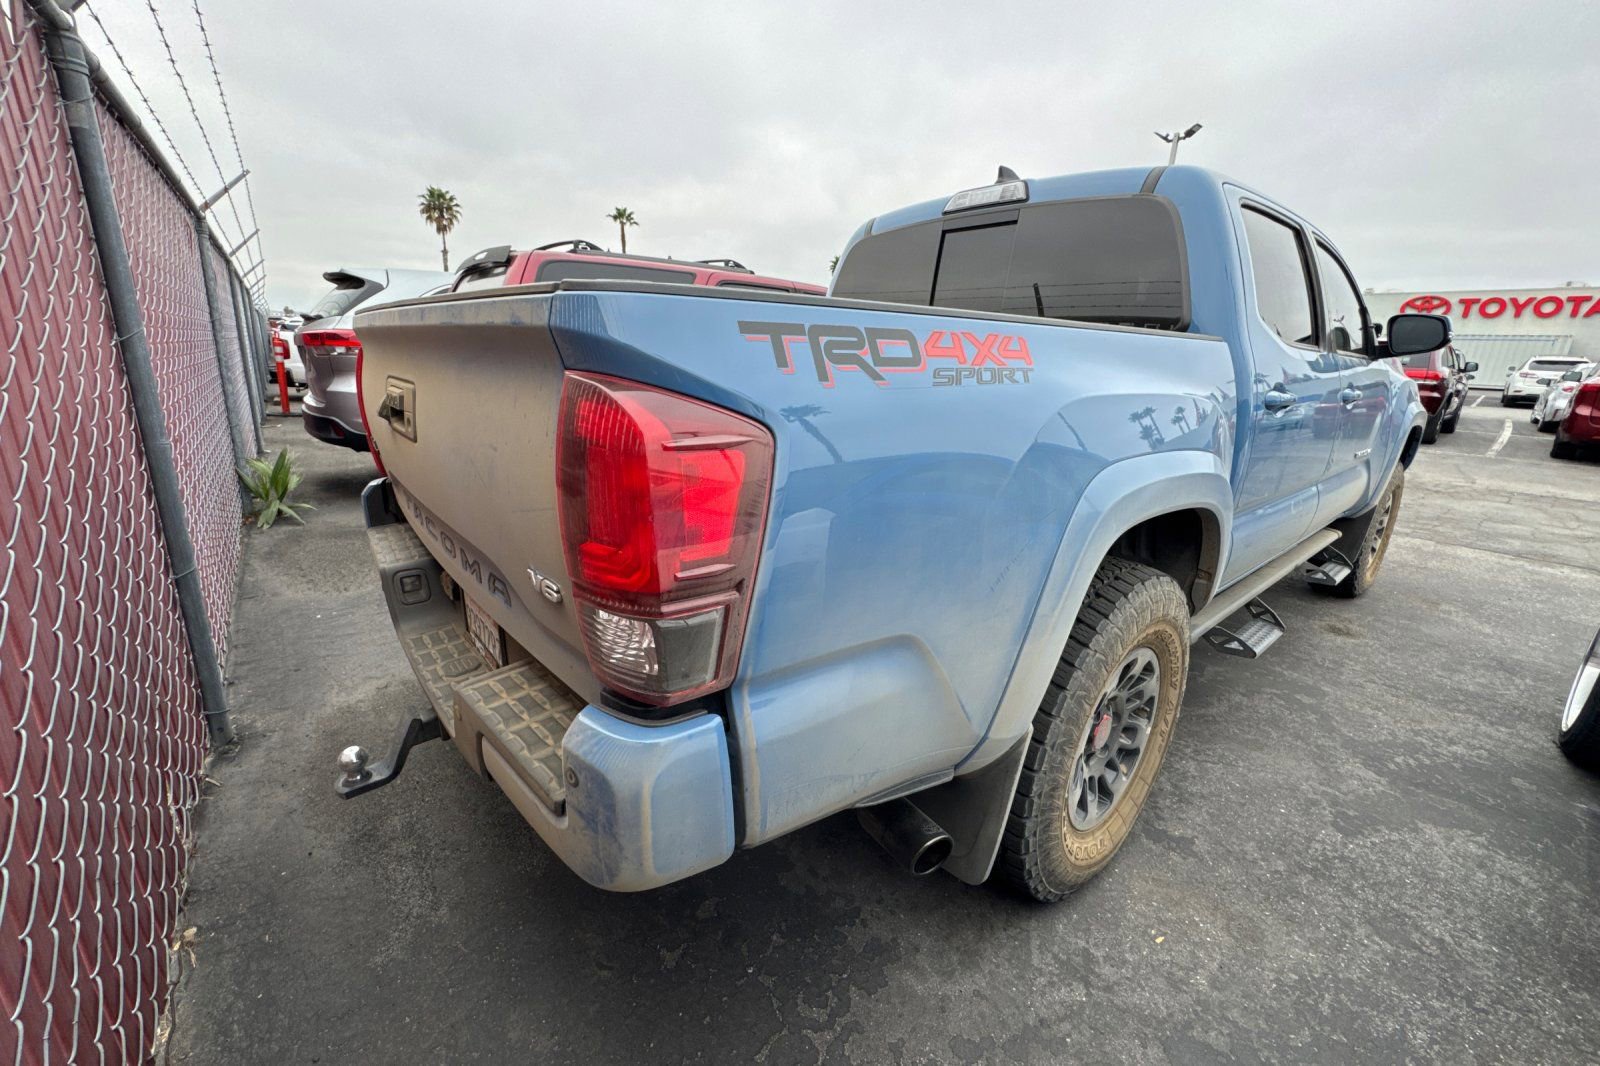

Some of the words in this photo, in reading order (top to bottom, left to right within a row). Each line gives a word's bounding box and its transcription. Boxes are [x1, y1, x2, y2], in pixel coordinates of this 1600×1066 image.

[737, 320, 927, 388] TRD
[931, 367, 1035, 387] SPORT
[405, 497, 513, 609] TACOMA
[527, 565, 563, 603] V6
